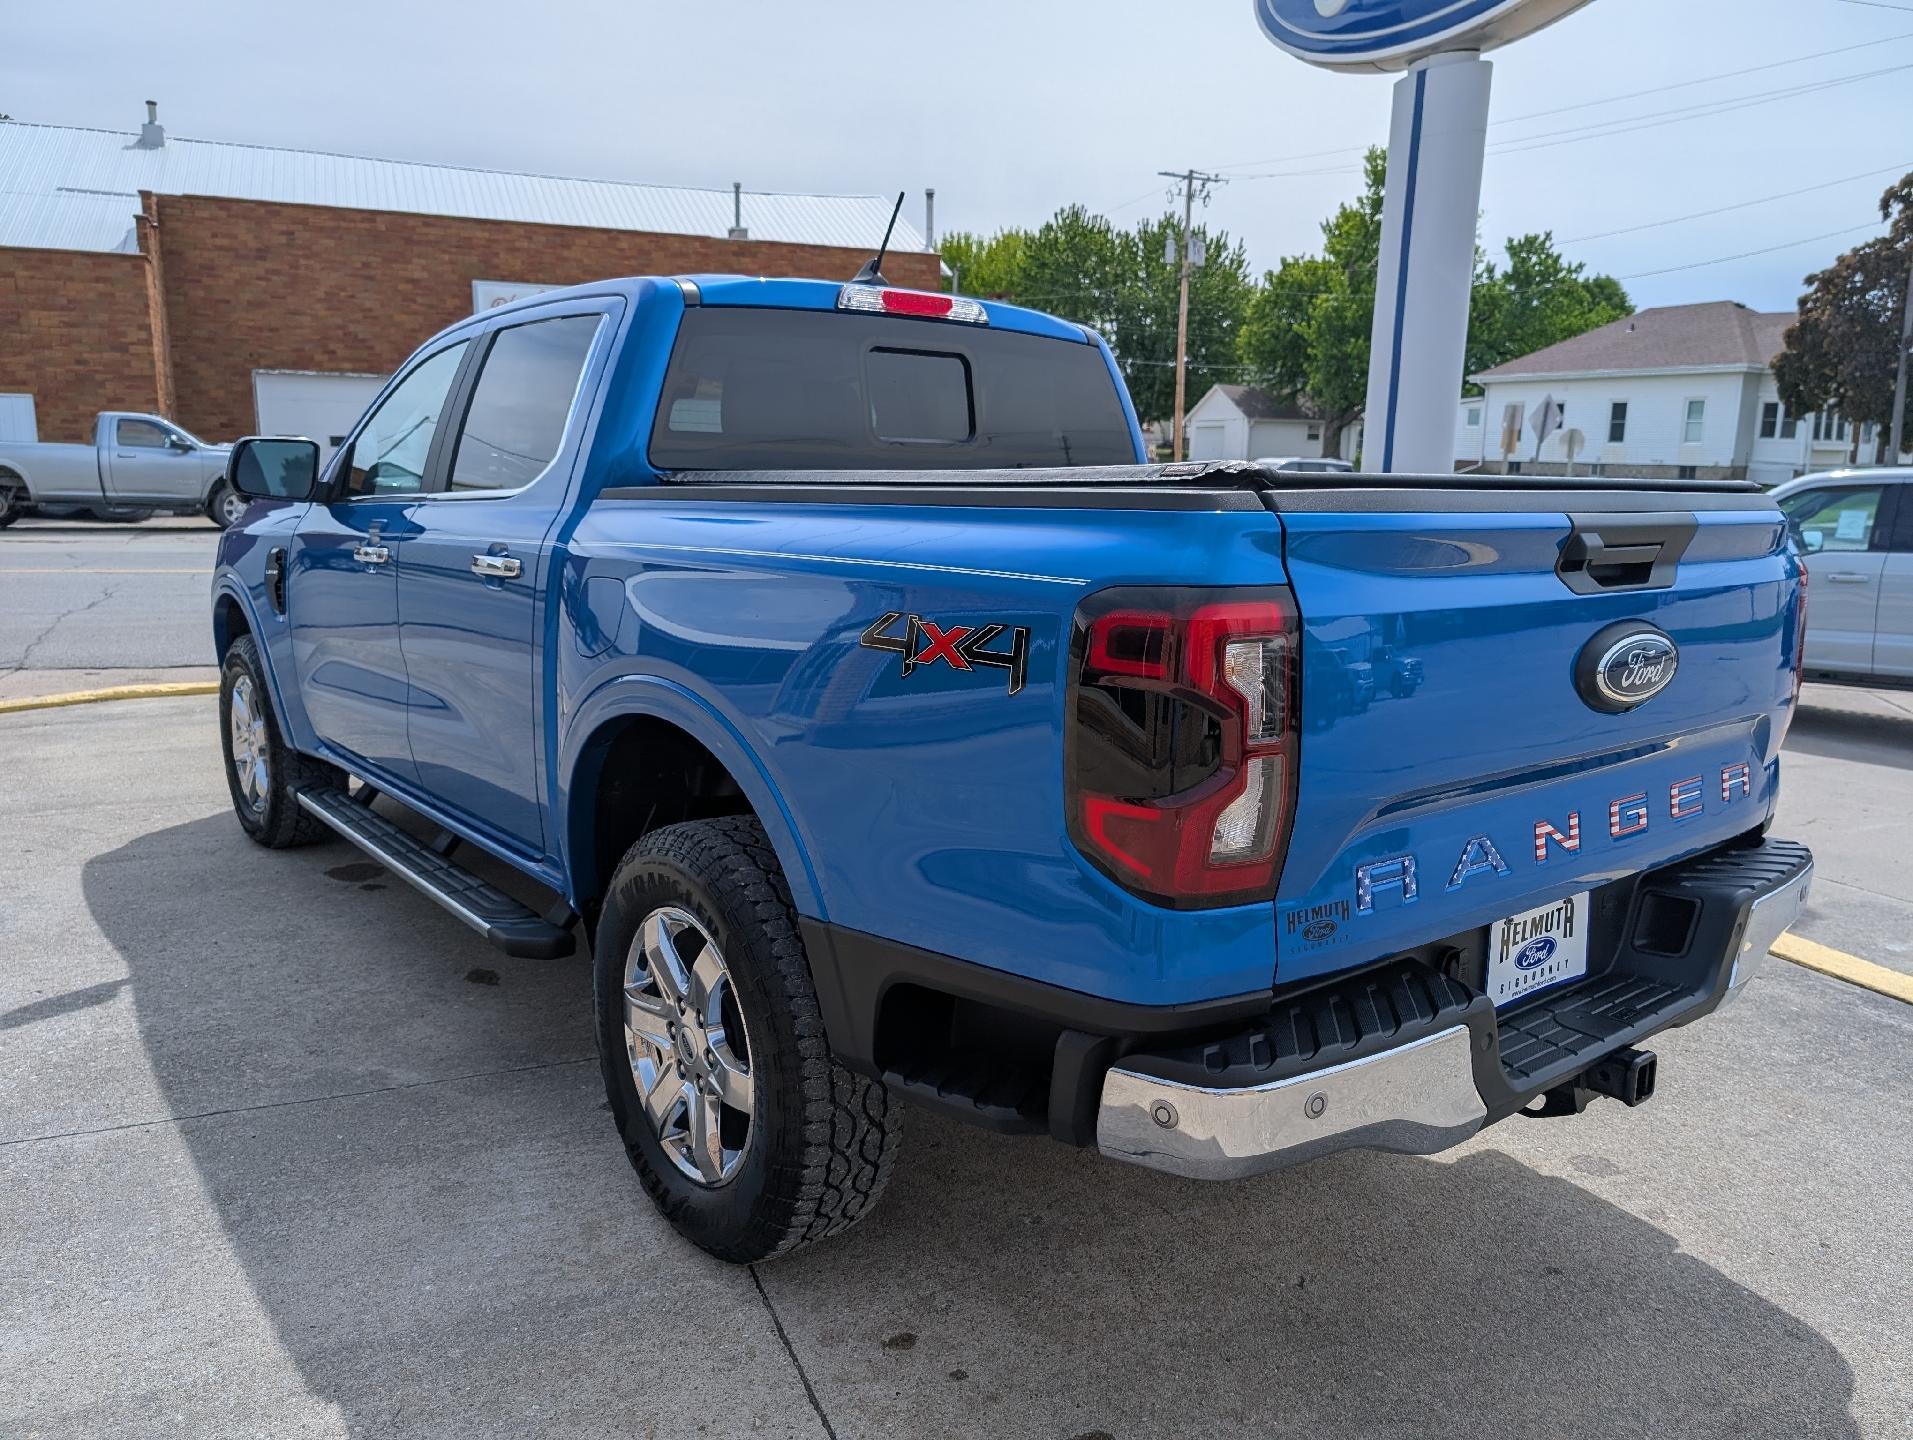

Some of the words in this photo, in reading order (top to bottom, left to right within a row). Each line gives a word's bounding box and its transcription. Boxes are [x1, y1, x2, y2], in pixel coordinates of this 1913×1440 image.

[1622, 649, 1666, 688] Ford
[1355, 762, 1751, 915] RANGER
[1287, 900, 1350, 935] HELMUTH
[1499, 897, 1575, 964] HELMUTH
[1522, 941, 1550, 966] Ford
